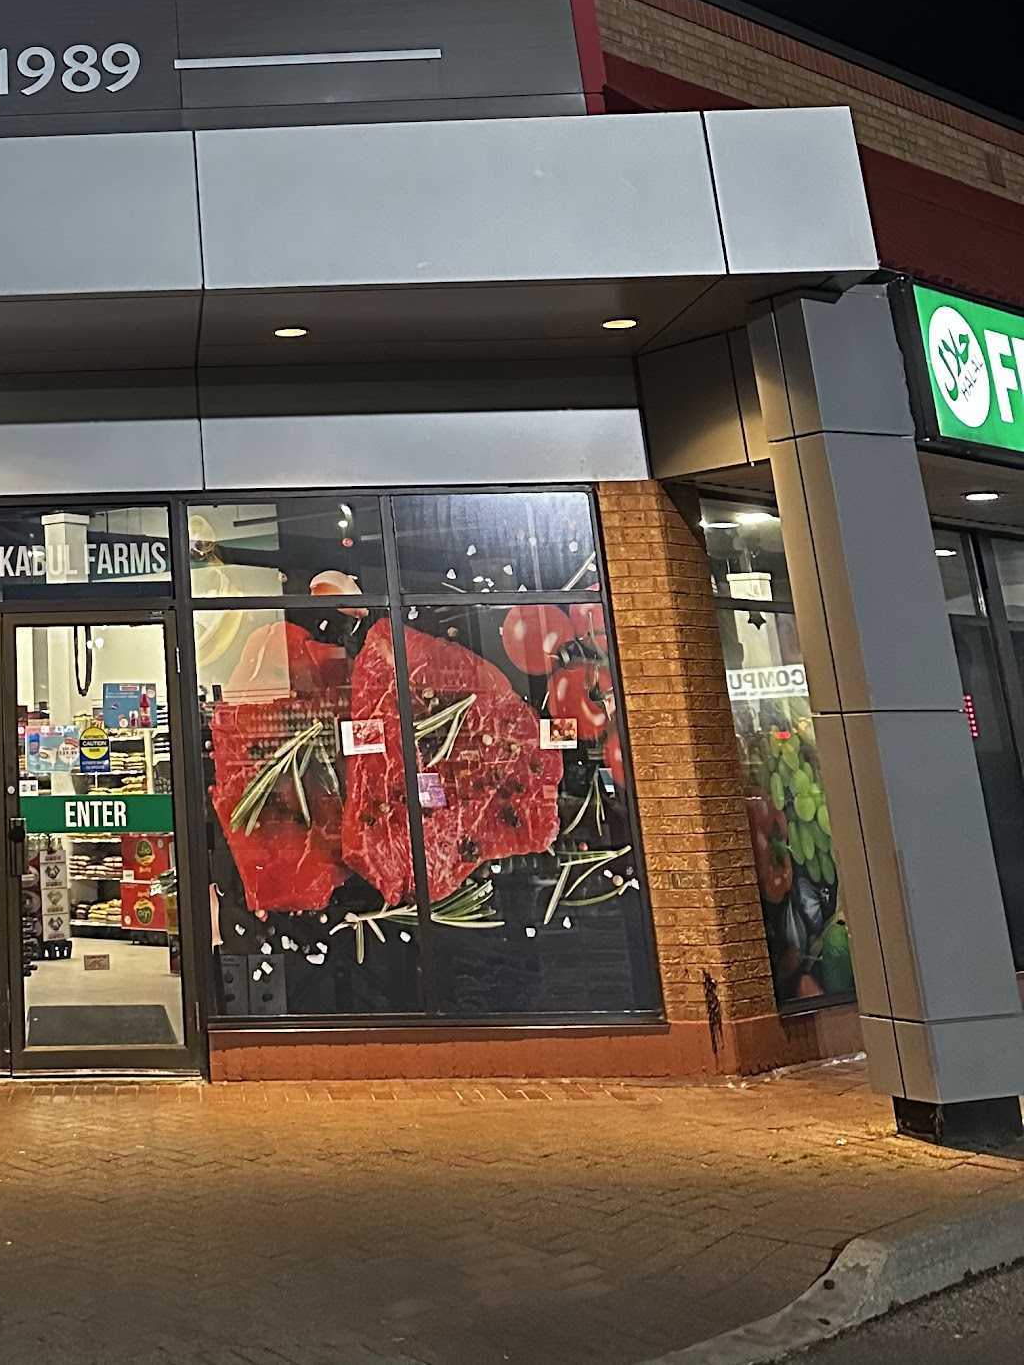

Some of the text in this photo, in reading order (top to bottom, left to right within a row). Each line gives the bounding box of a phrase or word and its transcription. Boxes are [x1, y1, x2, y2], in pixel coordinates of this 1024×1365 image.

[960, 354, 984, 402] HALAL
[0, 543, 77, 578] KABUL
[84, 542, 166, 575] FARMS
[64, 800, 127, 828] ENTER
